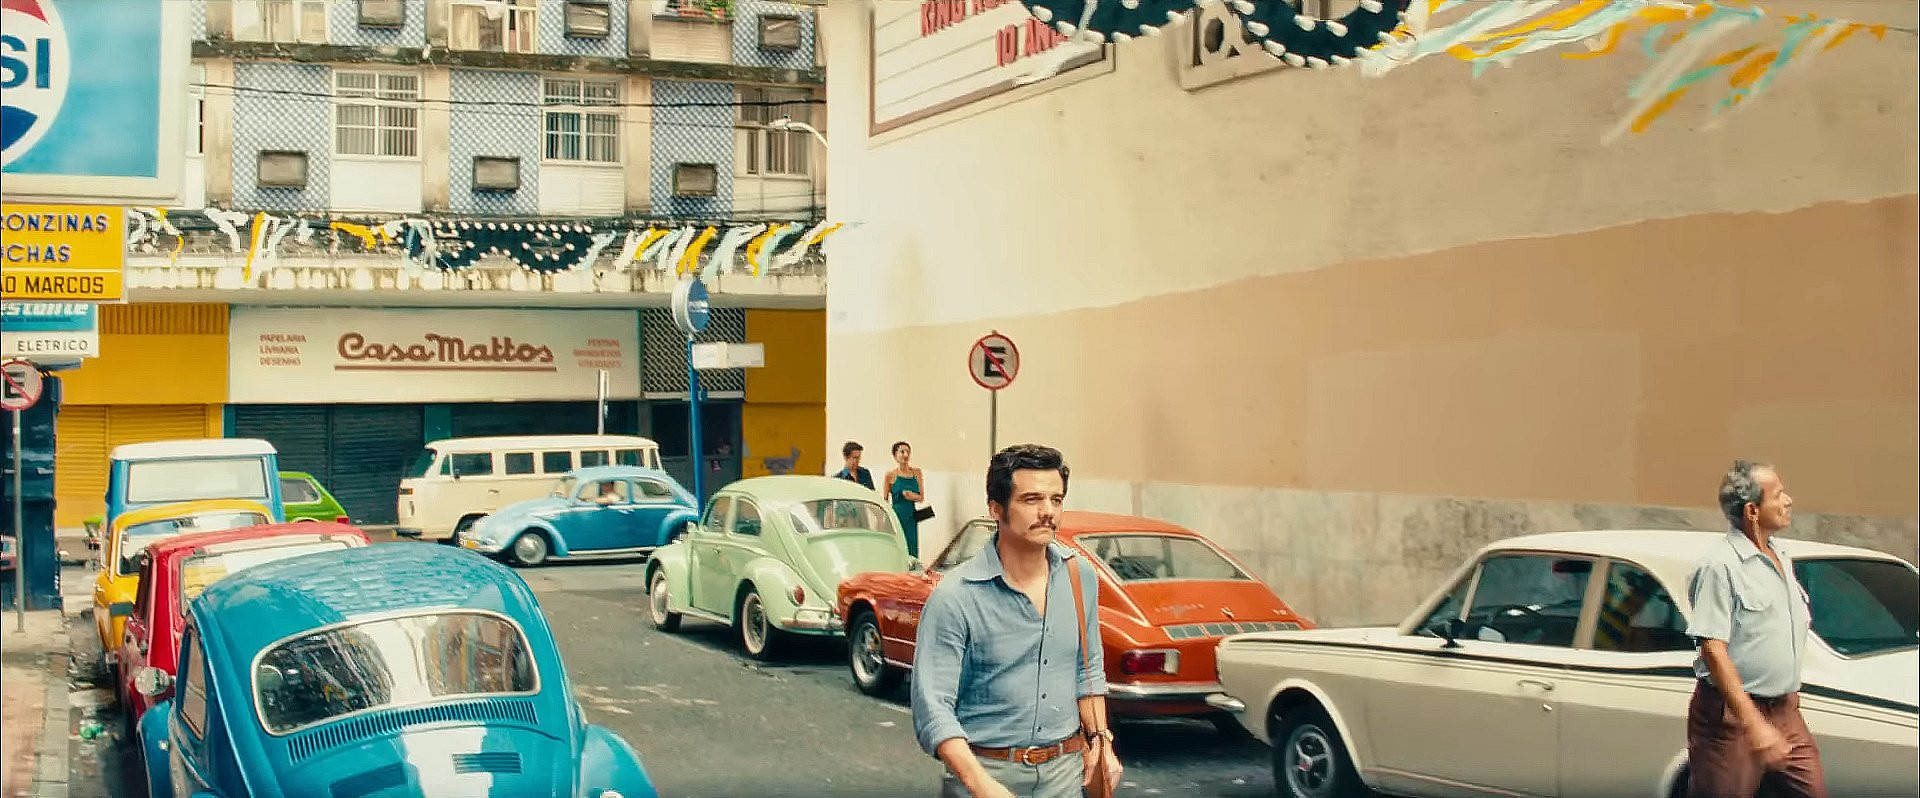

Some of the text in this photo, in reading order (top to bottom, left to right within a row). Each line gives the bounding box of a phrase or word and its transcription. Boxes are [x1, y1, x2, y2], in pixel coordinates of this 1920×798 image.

[1, 212, 108, 232] ONZINAS
[1, 244, 71, 262] CHAS
[25, 275, 104, 294] MARCOS
[17, 340, 88, 352] ELETRICO
[338, 331, 554, 362] Casa Mattos
[984, 345, 1008, 378] E
